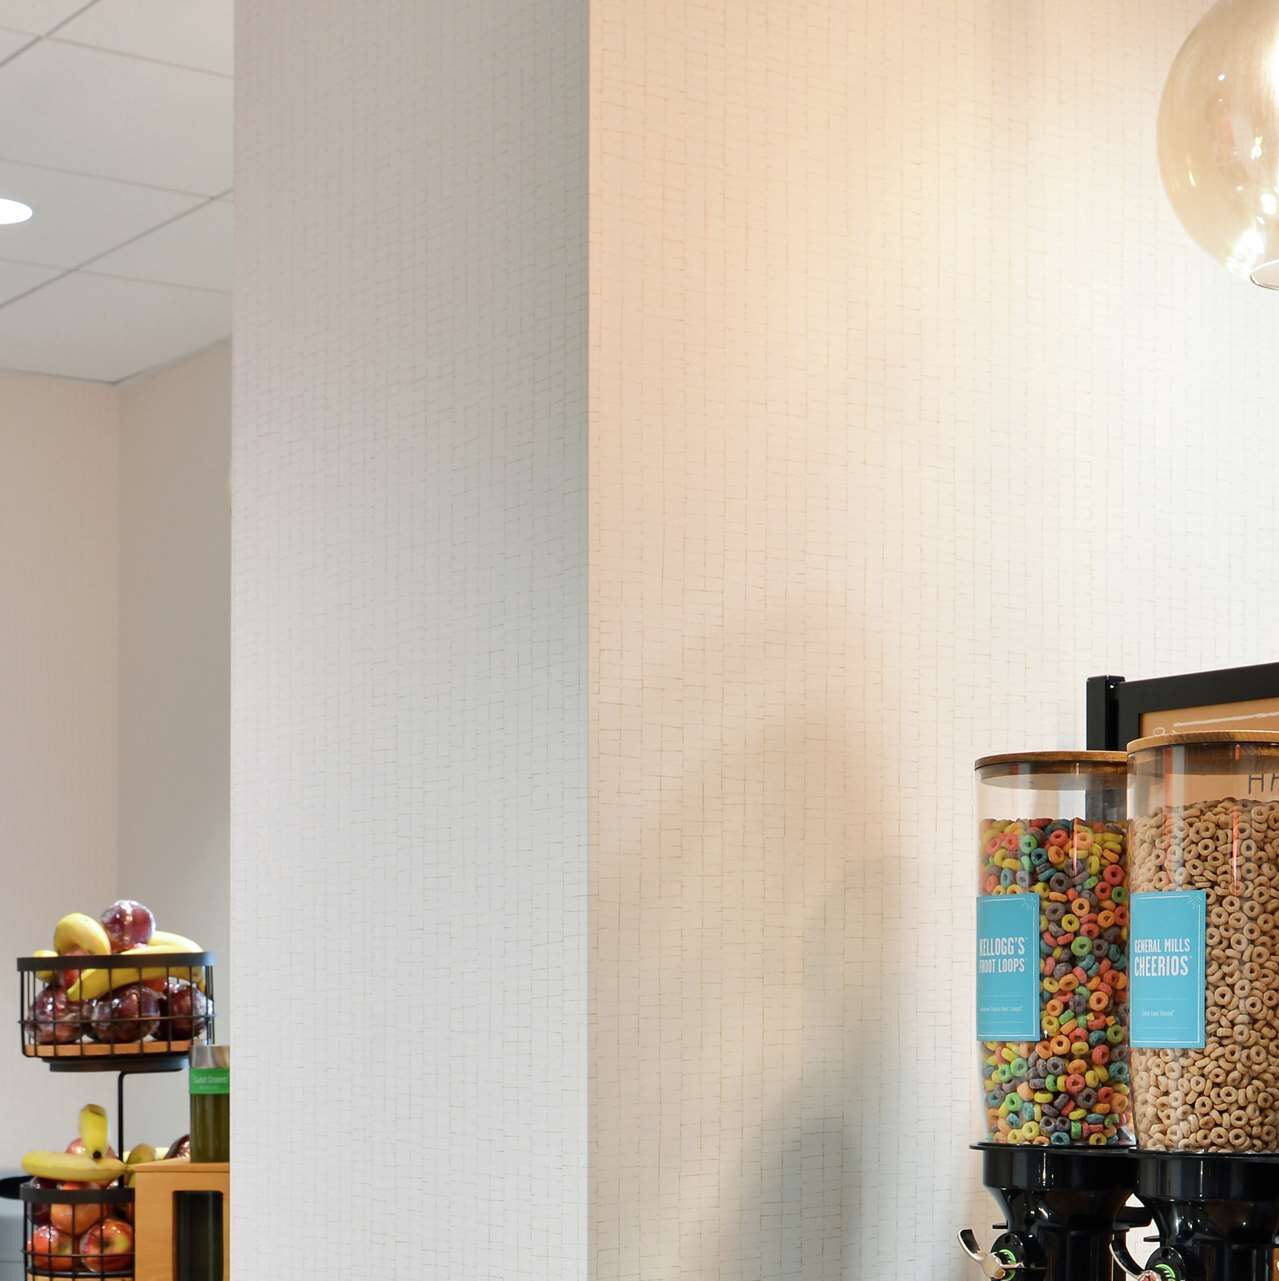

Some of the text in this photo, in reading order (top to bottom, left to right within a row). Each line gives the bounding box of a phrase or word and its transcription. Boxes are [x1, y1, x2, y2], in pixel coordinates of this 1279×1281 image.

[1134, 937, 1191, 953] GENERAL MILLS
[998, 958, 1025, 973] LOOPS
[1134, 955, 1189, 977] CHEERIOS
